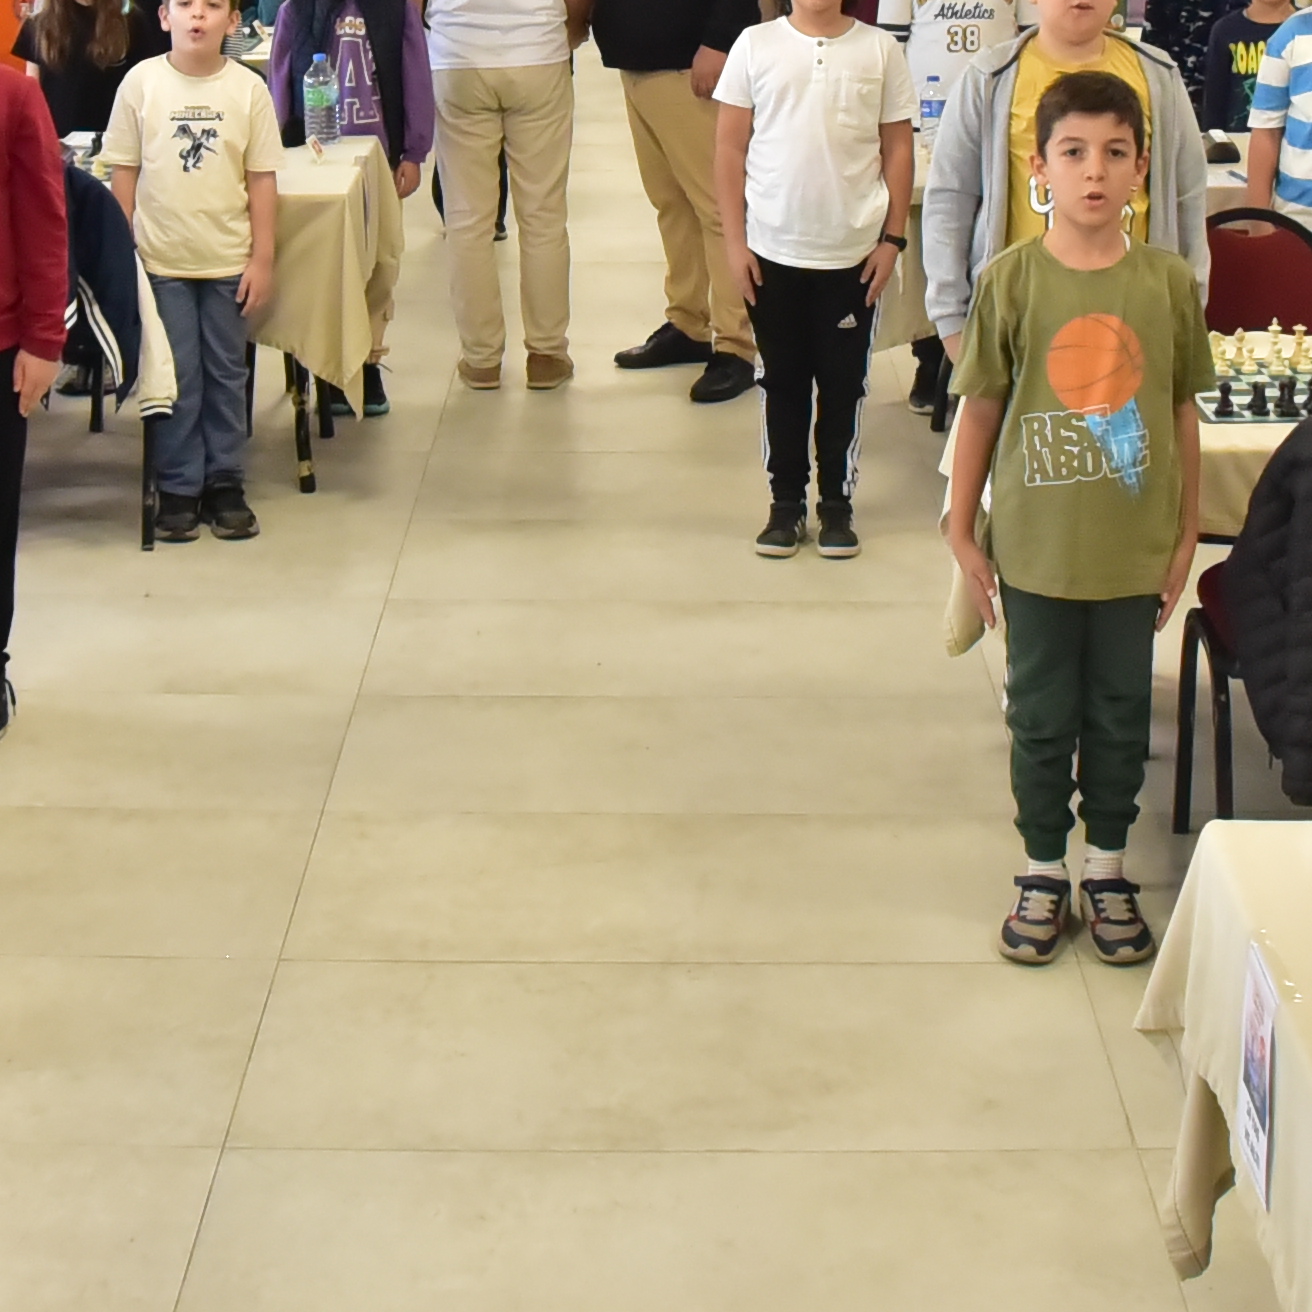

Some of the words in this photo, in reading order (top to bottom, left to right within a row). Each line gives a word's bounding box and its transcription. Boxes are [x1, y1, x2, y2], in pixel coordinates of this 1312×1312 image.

[934, 1, 996, 21] Athletics
[946, 24, 981, 53] 38
[1021, 404, 1111, 445] RISE
[1024, 430, 1151, 486] ABOVE
